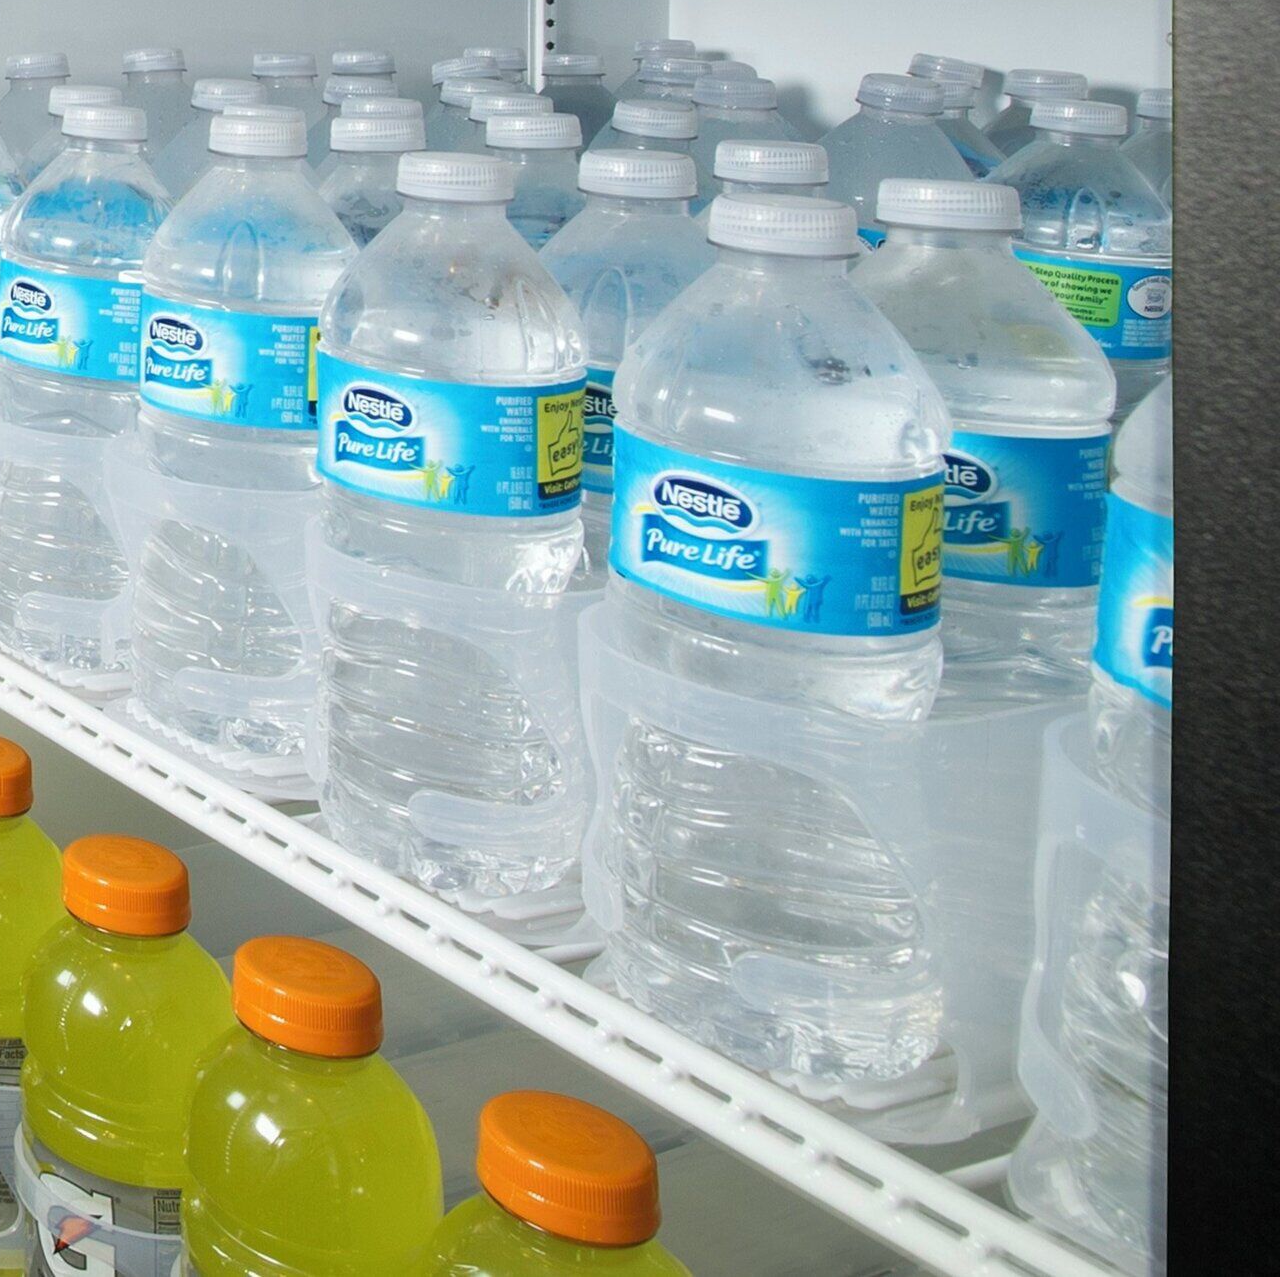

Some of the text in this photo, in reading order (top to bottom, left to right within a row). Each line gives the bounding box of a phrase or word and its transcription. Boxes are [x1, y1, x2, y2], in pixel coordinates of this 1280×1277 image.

[1055, 270, 1119, 286] Quality Process
[1060, 281, 1099, 295] showing
[1099, 286, 1113, 295] we
[3, 316, 55, 338] Pure Life
[146, 357, 207, 382] Pure Life
[496, 396, 533, 406] PURIFIED
[544, 398, 569, 414] Enjoy
[506, 407, 533, 416] WATER
[500, 434, 513, 442] FOR
[338, 433, 417, 463] Pure Life
[858, 493, 900, 504] PURIFIED
[910, 497, 933, 512] Enjoy
[869, 506, 899, 517] WATER
[944, 510, 998, 535] Life
[647, 528, 757, 571] Pure Life
